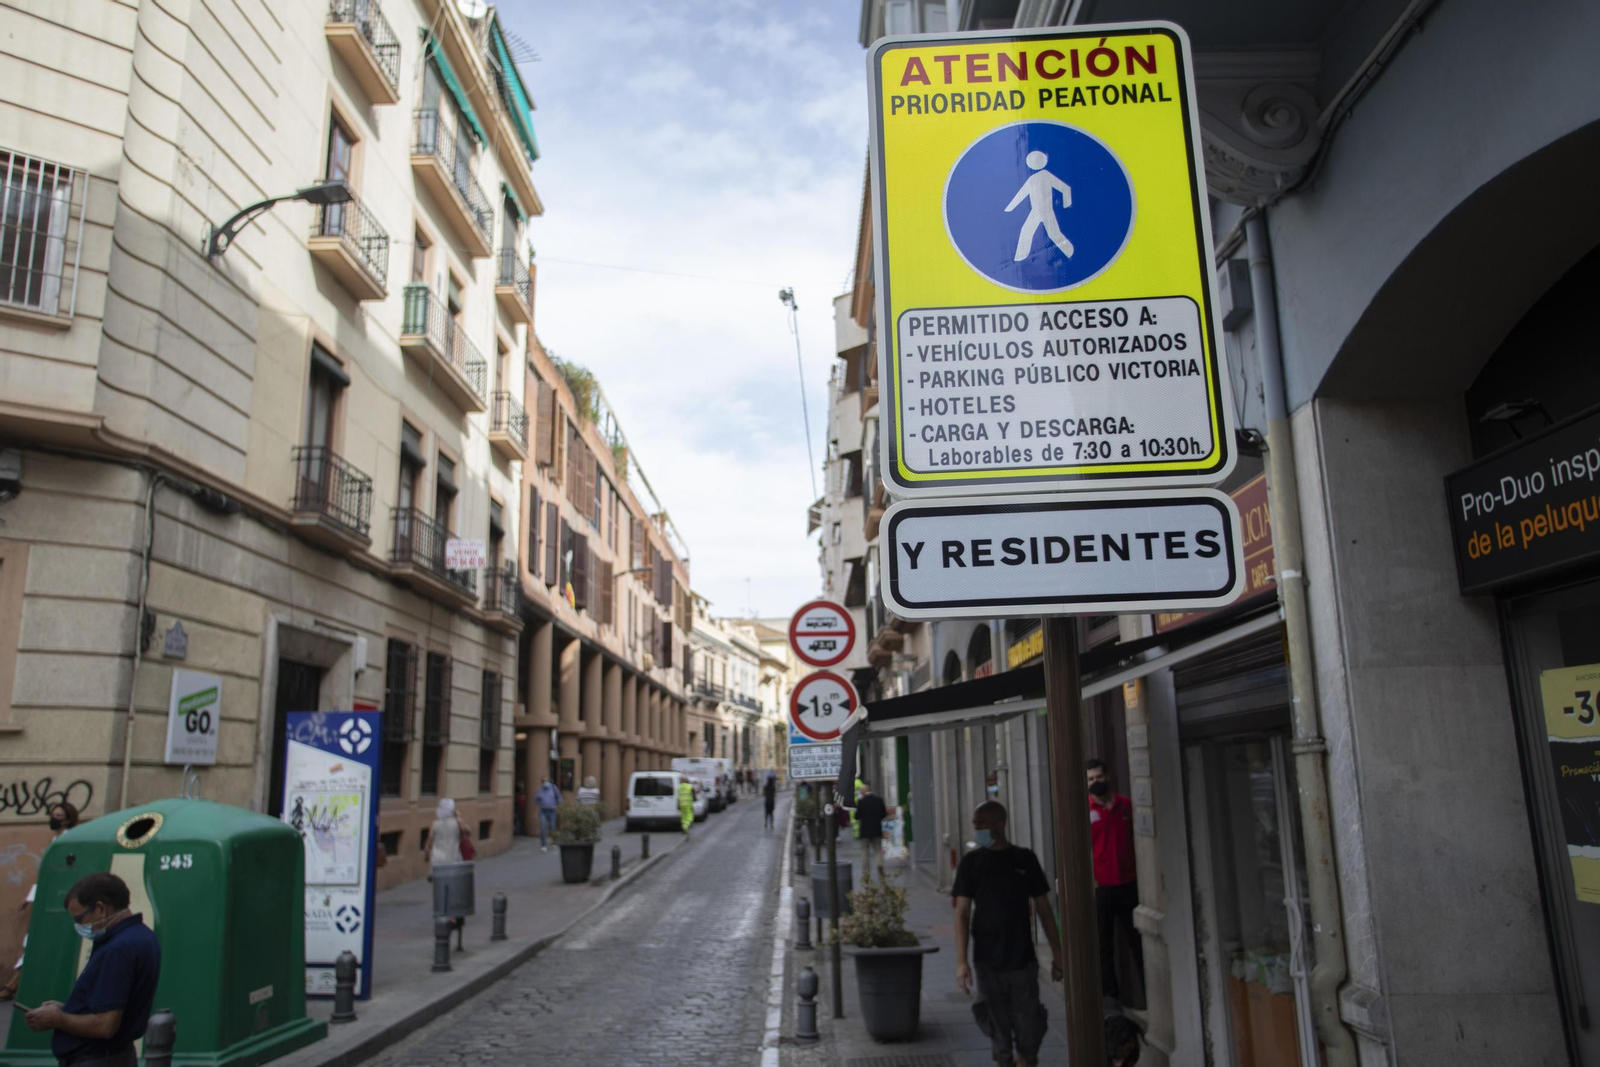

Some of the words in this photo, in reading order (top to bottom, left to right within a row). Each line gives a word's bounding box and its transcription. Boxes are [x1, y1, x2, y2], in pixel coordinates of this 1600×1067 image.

[899, 37, 1158, 86] ATENCIÓN
[891, 89, 1025, 116] PRIORIDAD
[1038, 81, 1173, 109] PEATONAL
[908, 311, 1029, 337] PERMITIDO
[1039, 306, 1129, 332] ACCESO
[1138, 305, 1158, 327] A:
[917, 339, 1034, 363] VEHÍCULOS
[1042, 332, 1187, 357] AUTORIZADOS
[919, 367, 1005, 389] PARKING
[1014, 362, 1100, 386] PÚBLICO
[1108, 358, 1201, 381] VICTORIA
[920, 394, 1016, 417] HOTELES
[921, 421, 989, 444] CARGA
[997, 422, 1010, 440] Y
[1019, 416, 1135, 439] DESCARGA:
[929, 445, 1033, 467] Laborables
[1041, 443, 1064, 462] de
[1073, 441, 1111, 461] 7:30
[1120, 444, 1131, 458] a
[1139, 436, 1206, 457] 10:30h.
[1461, 471, 1545, 521] Pro-Duo
[1468, 530, 1492, 559] de
[1495, 521, 1516, 550] la
[1520, 495, 1600, 549] peluqu
[901, 541, 925, 570] Y
[941, 529, 1222, 569] RESIDENTES
[160, 854, 193, 871] 245
